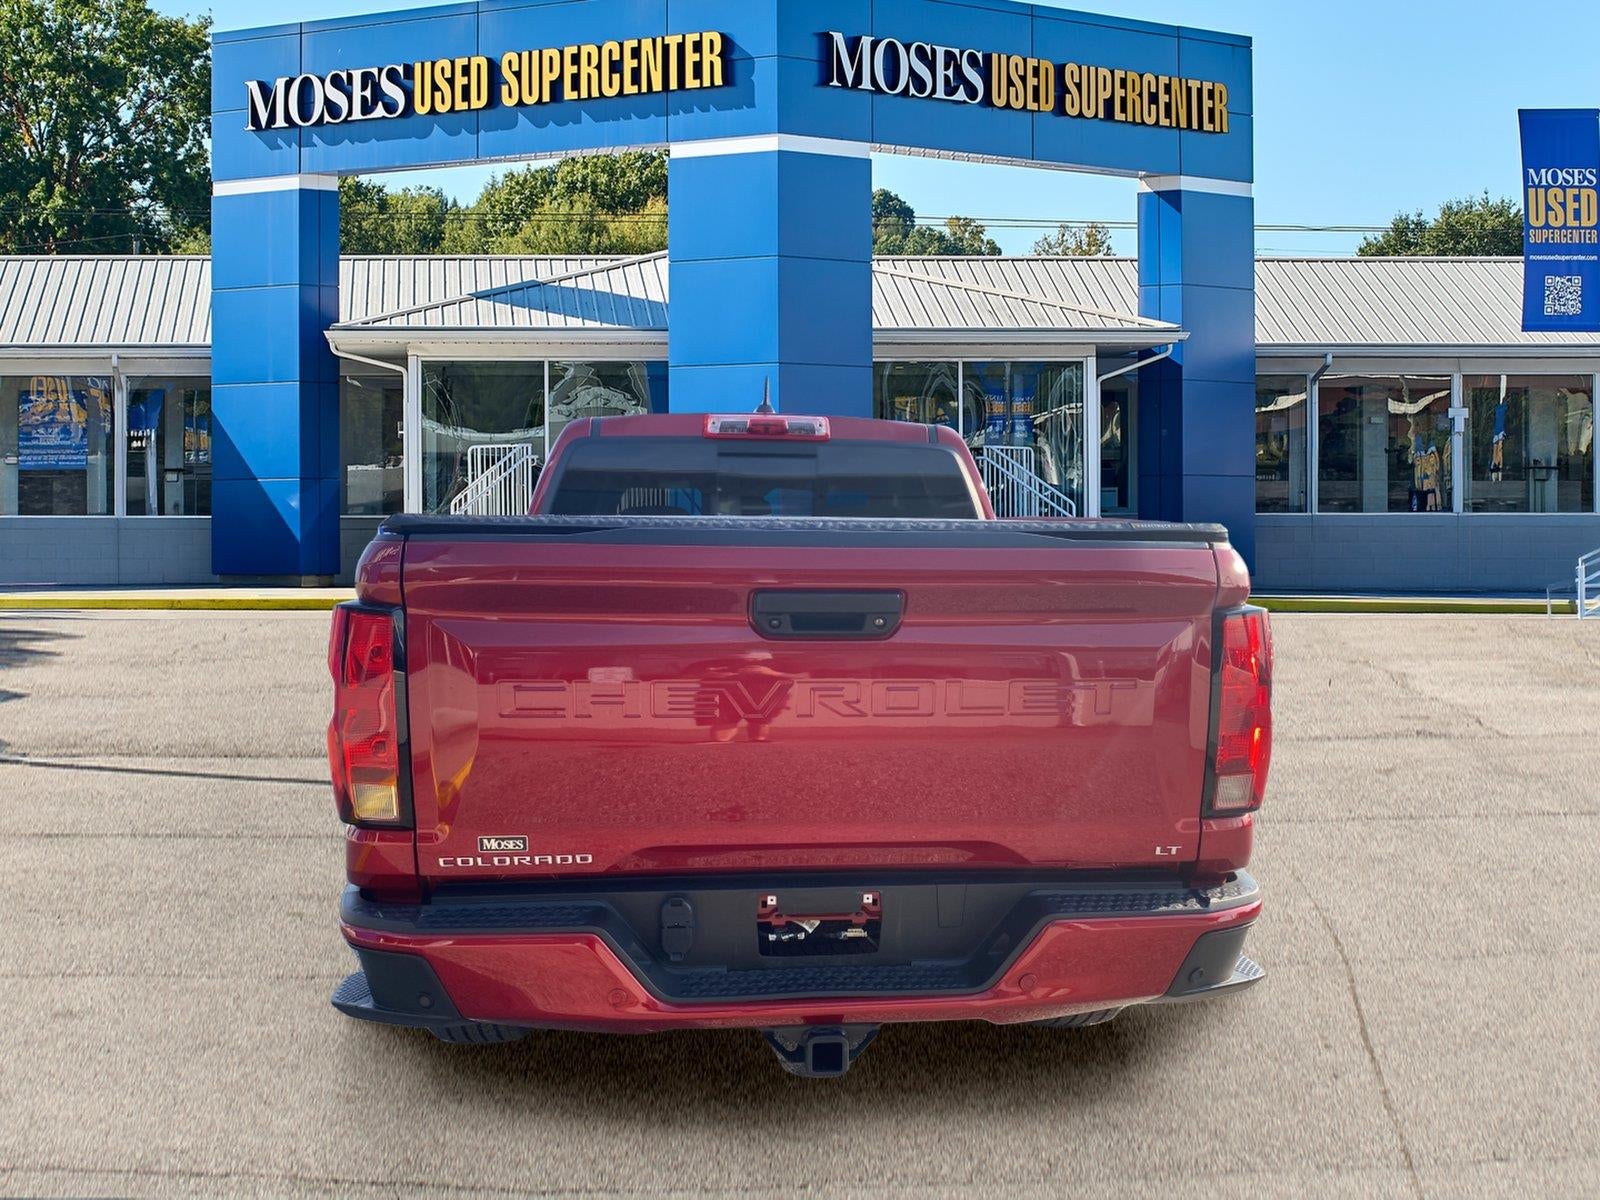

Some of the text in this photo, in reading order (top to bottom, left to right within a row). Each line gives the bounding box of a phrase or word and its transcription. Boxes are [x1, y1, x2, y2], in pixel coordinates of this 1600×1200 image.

[244, 31, 724, 132] MOSES USED SUPERCENTER
[828, 31, 1229, 134] MOSES USED SUPERCENTER
[1527, 168, 1597, 186] MOSES
[1528, 188, 1597, 227] USED
[1529, 229, 1598, 243] SUPERCENTER
[496, 679, 1138, 719] CHEVROLET
[438, 854, 593, 867] COLORADO
[1155, 846, 1182, 855] LT
